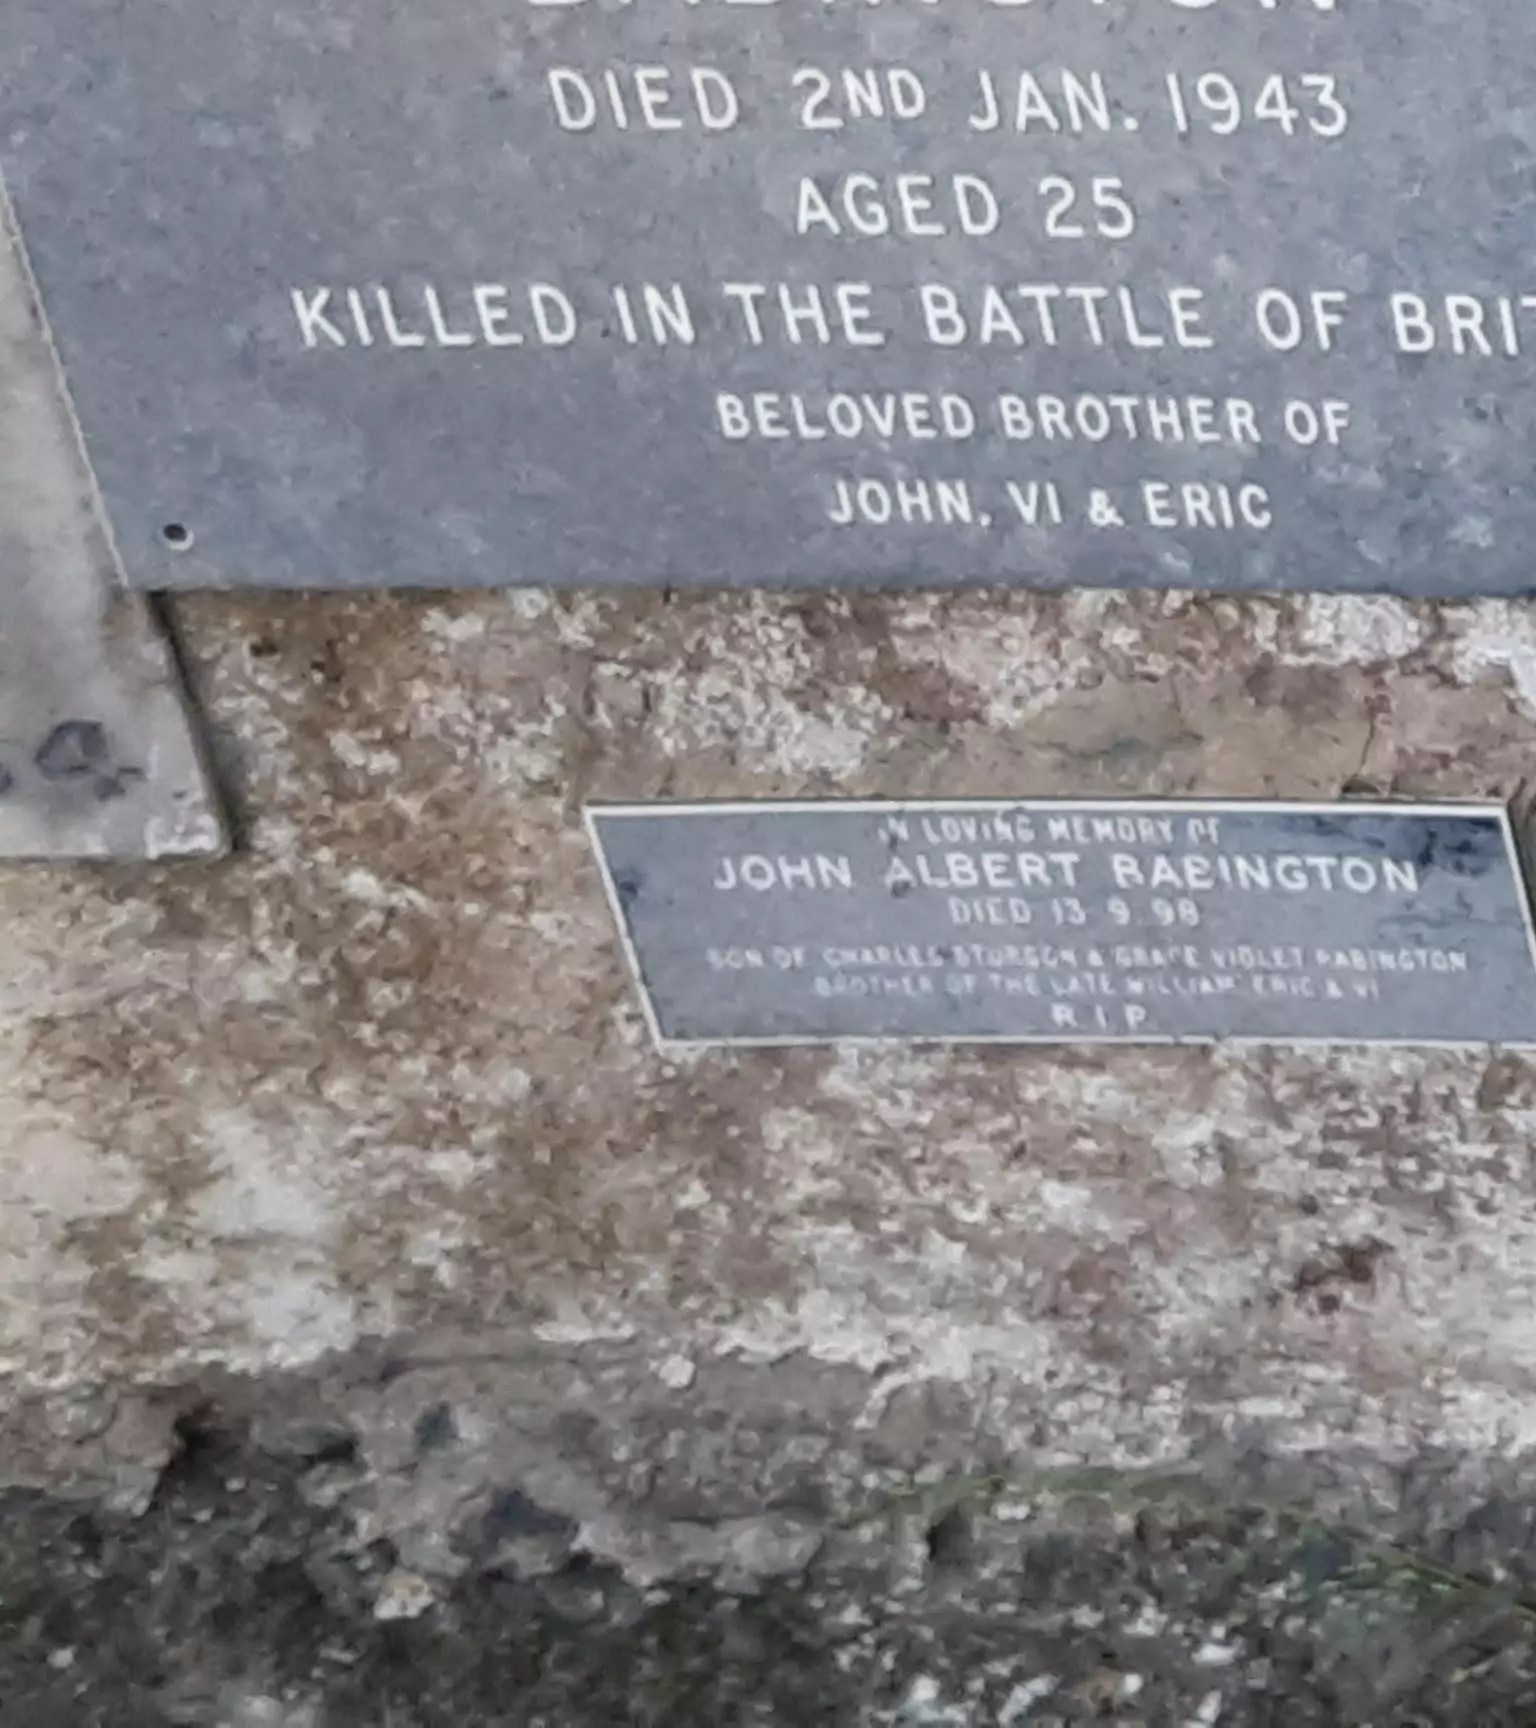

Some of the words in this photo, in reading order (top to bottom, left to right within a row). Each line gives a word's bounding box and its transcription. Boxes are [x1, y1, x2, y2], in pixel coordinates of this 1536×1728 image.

[547, 66, 739, 130] DIED
[791, 67, 926, 130] 2ND
[968, 68, 1139, 132] JAN.
[1166, 71, 1348, 137] 1943
[797, 174, 999, 236] AGED
[1038, 175, 1134, 239] 25
[291, 283, 577, 347] KILLED
[613, 283, 695, 344] IN
[722, 282, 885, 345] THE
[920, 283, 1214, 349] BATTLE
[1255, 288, 1347, 351] OF
[715, 392, 975, 439] BELOVED
[998, 394, 1262, 445] BROTHER
[1283, 399, 1350, 445] OF
[1006, 480, 1062, 525] VI
[1087, 489, 1125, 527] &
[1142, 481, 1272, 529] ERIC
[921, 815, 1035, 845] LOVING
[1049, 817, 1174, 845] MEMORY
[714, 852, 853, 892] JOHN
[883, 850, 1081, 890] ALBERT
[949, 896, 1033, 925] DIED
